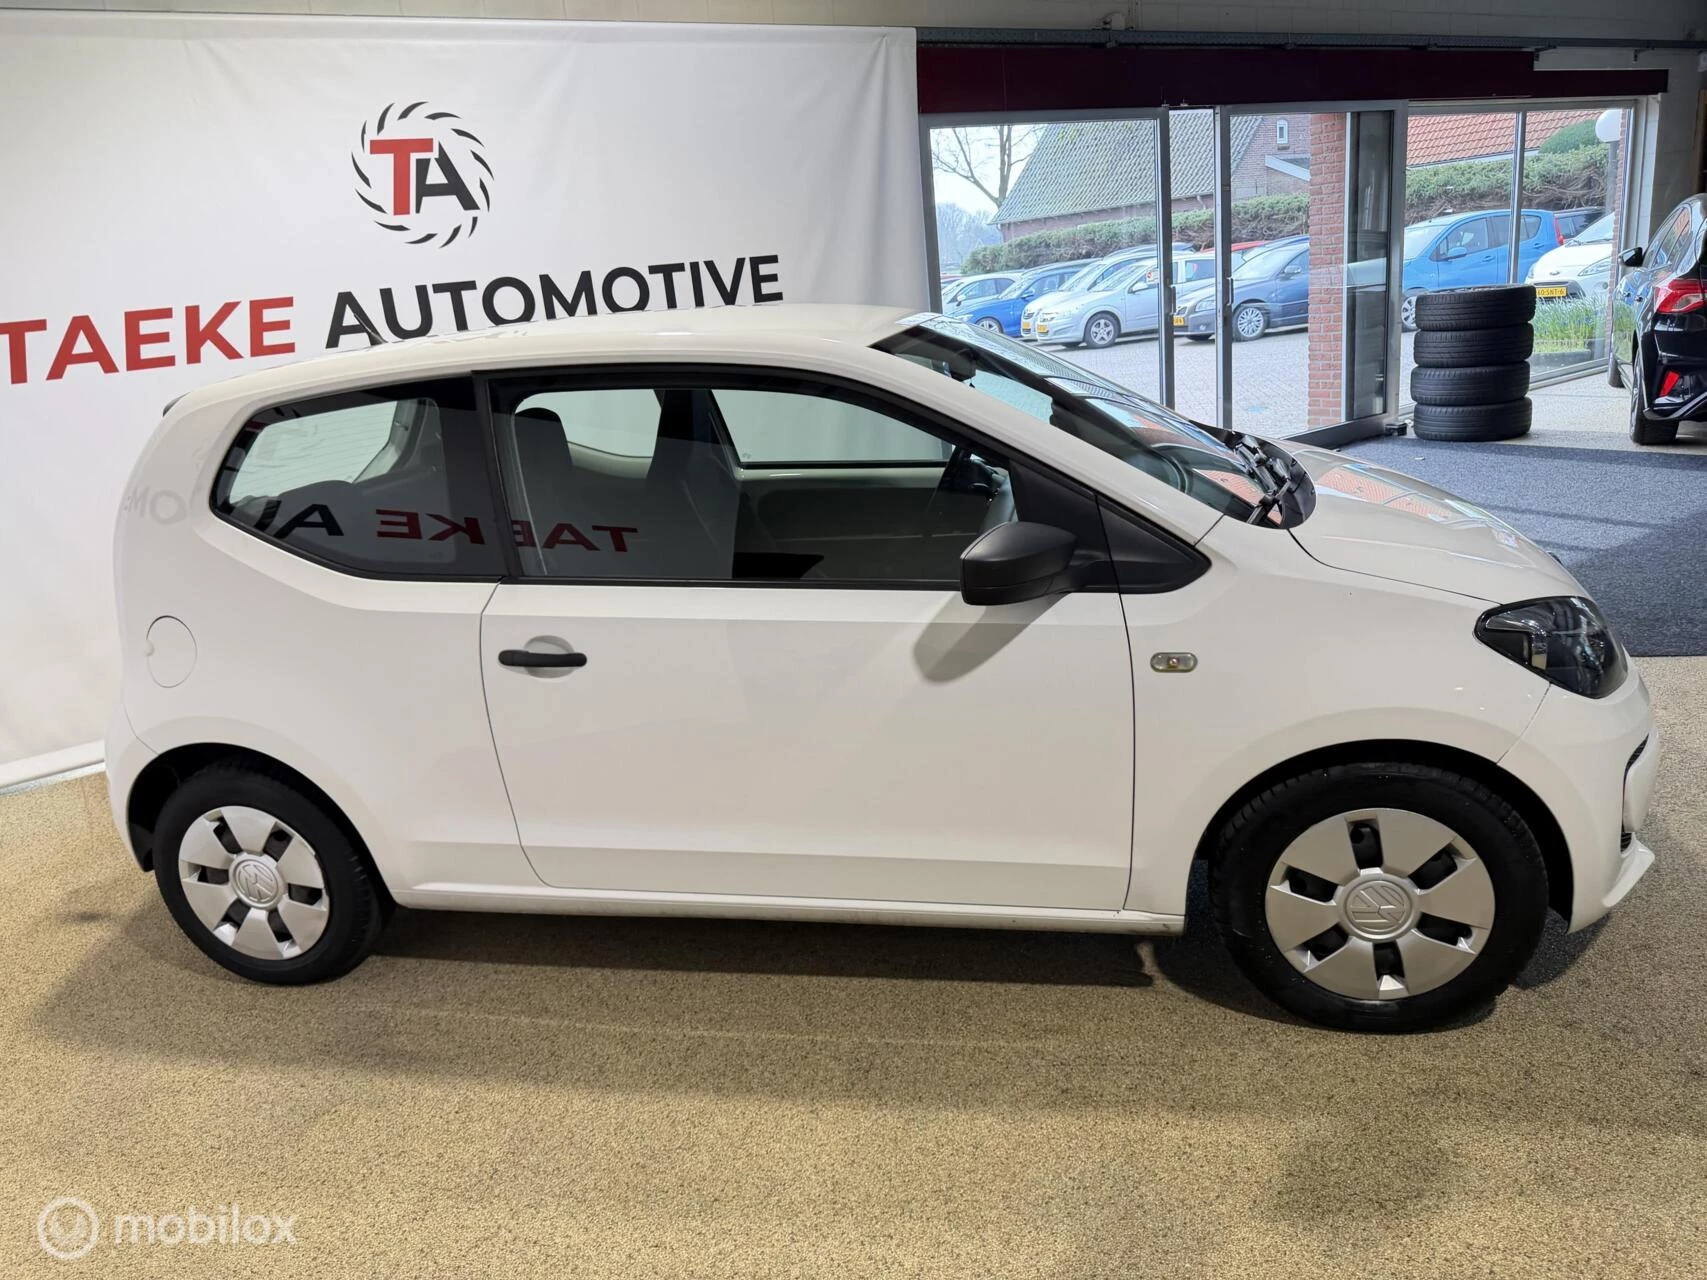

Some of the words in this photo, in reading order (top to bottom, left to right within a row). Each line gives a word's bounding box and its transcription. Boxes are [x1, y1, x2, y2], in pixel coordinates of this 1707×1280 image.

[369, 137, 481, 216] TA
[0, 296, 296, 385] TAEKE
[325, 254, 784, 349] AUTOMOTIVE
